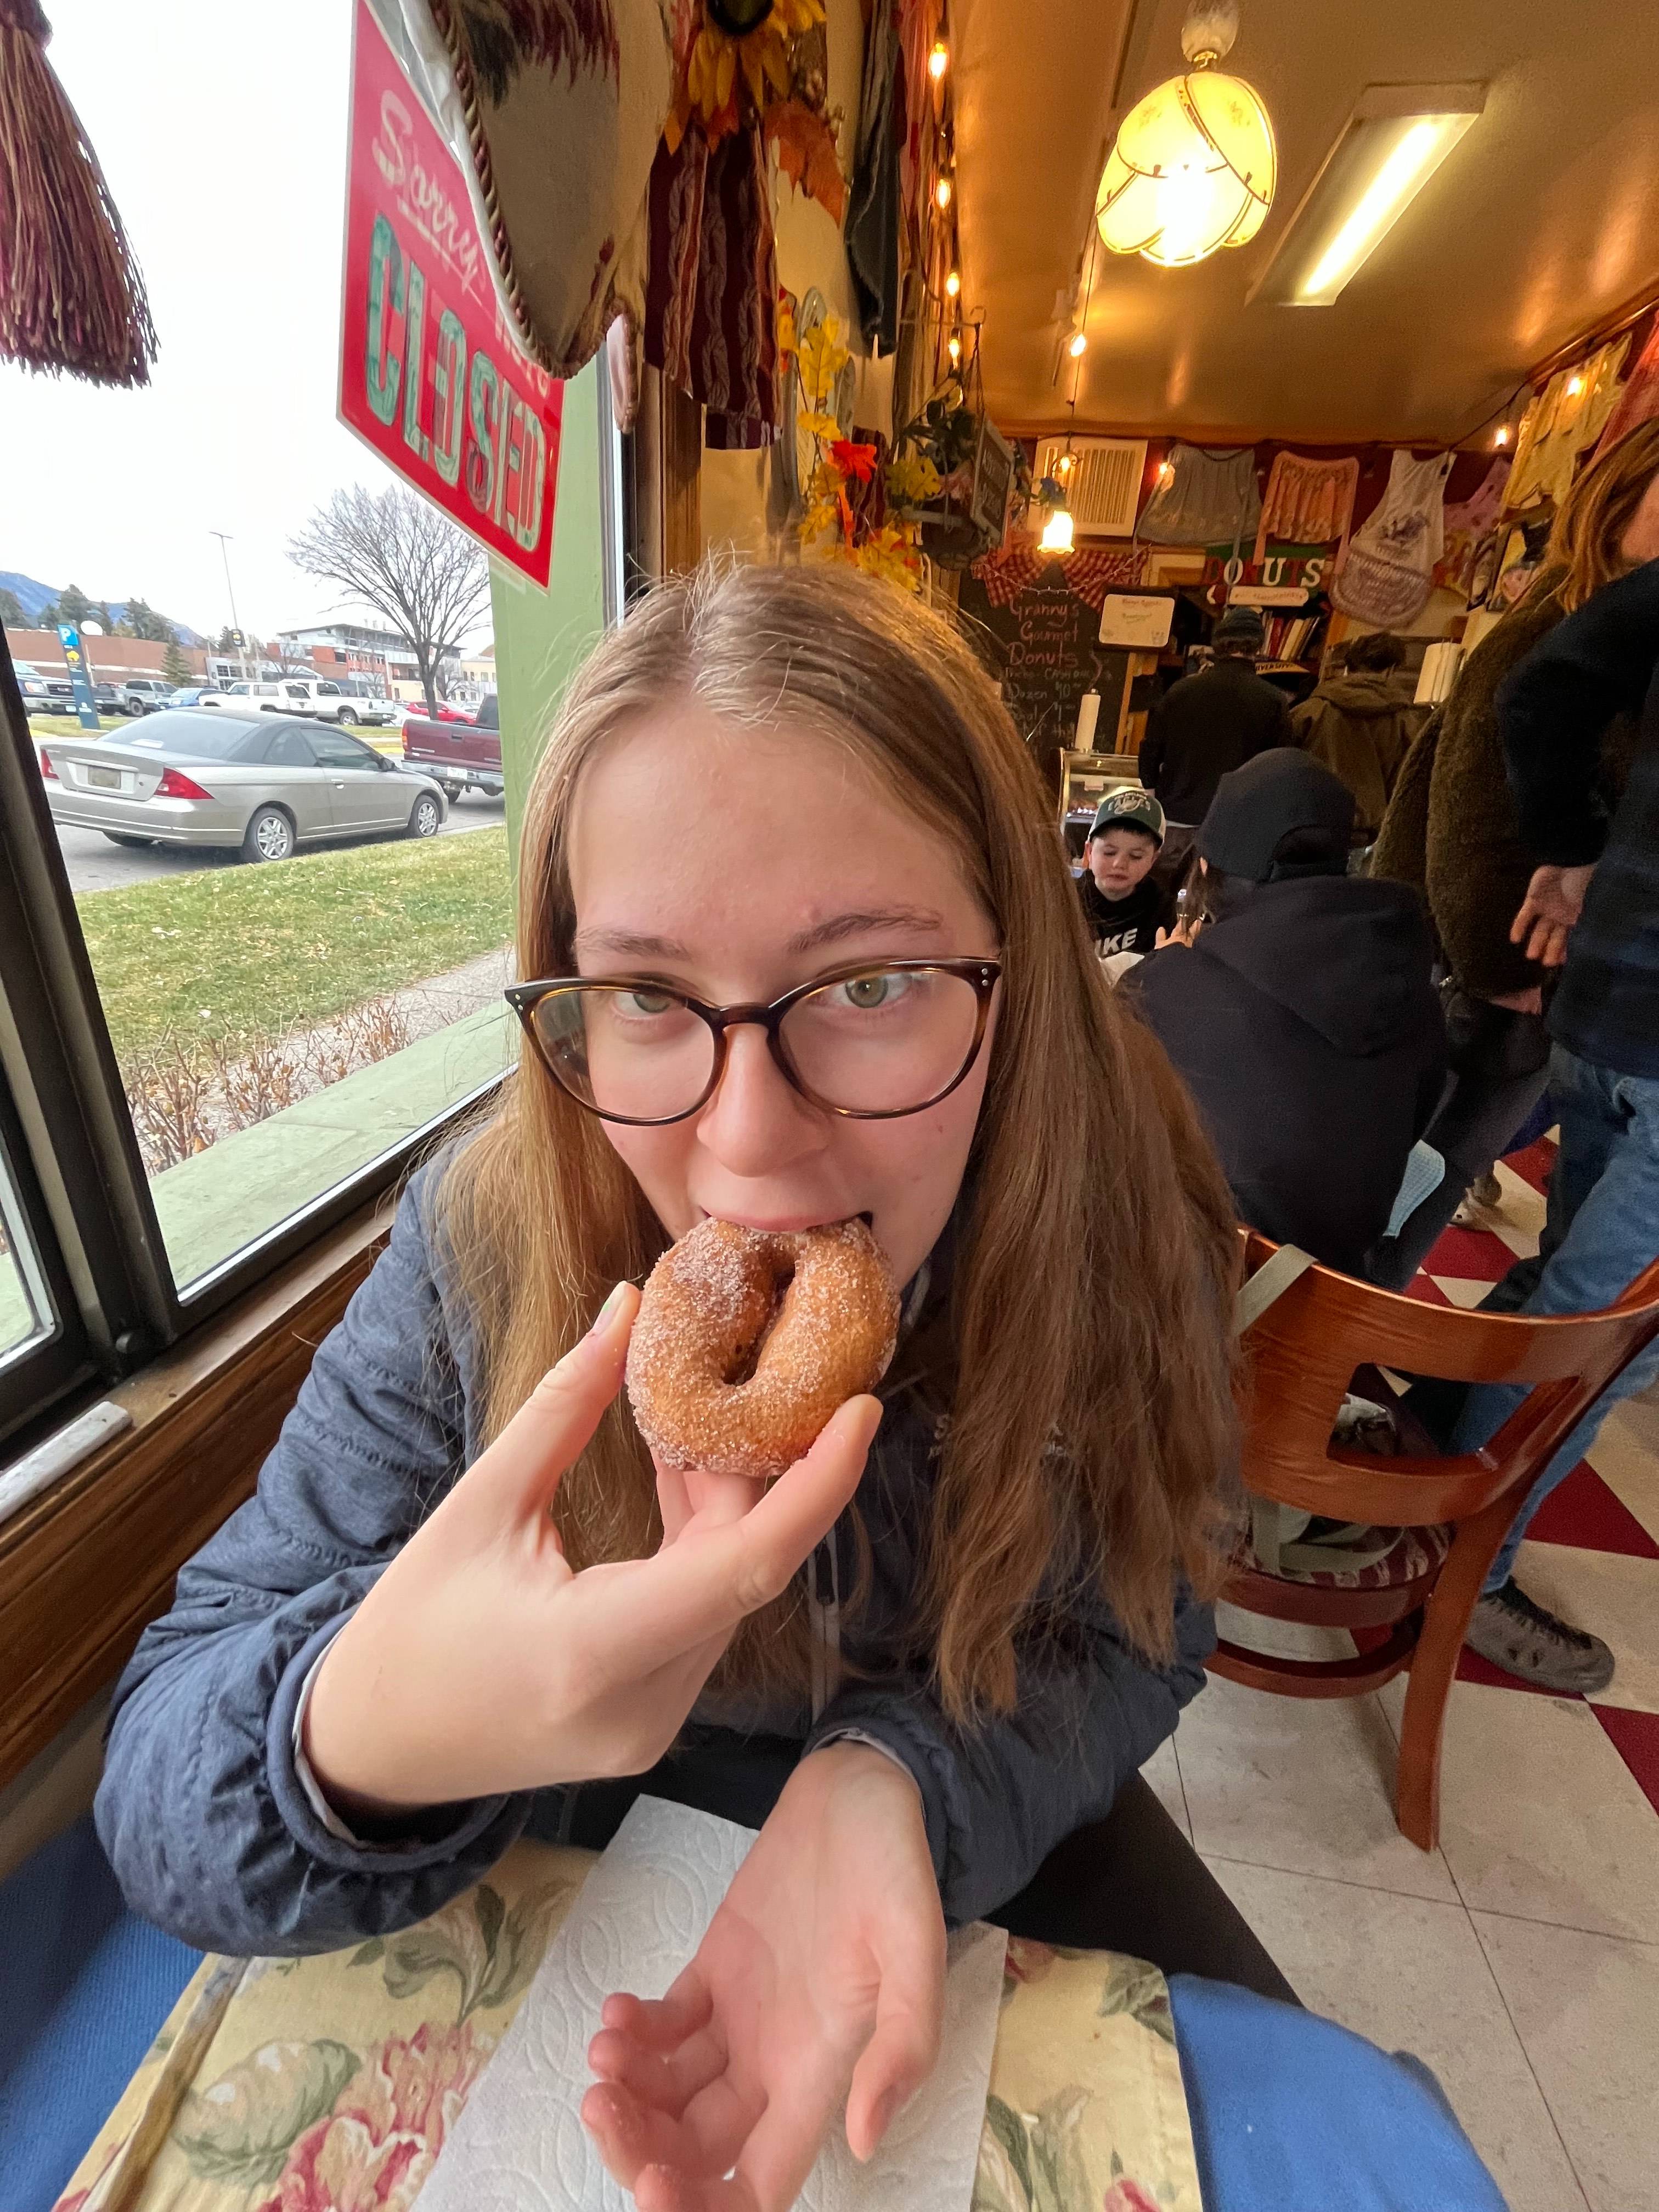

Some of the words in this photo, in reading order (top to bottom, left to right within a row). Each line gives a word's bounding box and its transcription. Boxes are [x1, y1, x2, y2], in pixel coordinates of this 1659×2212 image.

[371, 90, 487, 296] Sorry
[365, 211, 548, 554] CLOSED
[1203, 557, 1325, 588] DONUTS
[1008, 641, 1079, 668] Donuts
[1094, 927, 1138, 955] IKE
